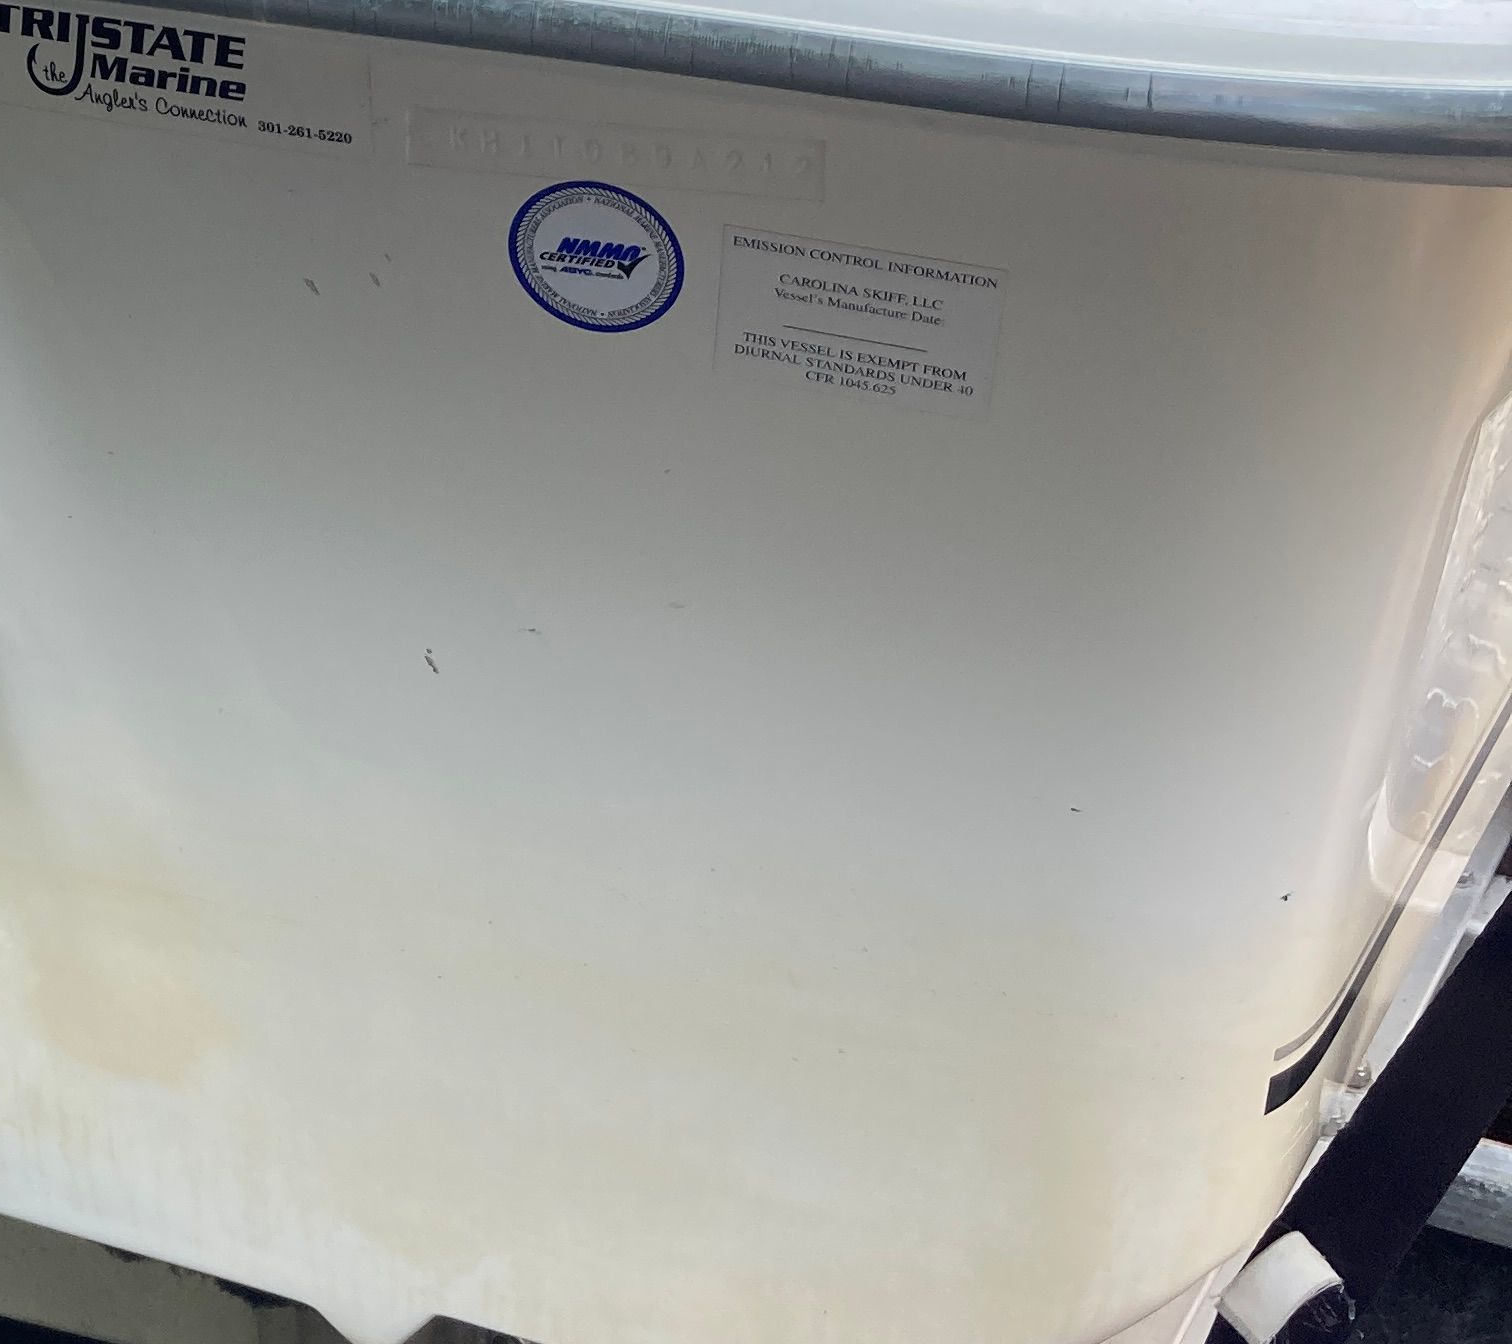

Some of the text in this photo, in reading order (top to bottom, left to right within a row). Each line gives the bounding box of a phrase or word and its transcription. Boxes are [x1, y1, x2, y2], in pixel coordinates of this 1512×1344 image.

[43, 52, 247, 102] the Marine
[74, 83, 248, 128] Angler's Connection
[257, 120, 353, 145] 301-261-5220
[539, 251, 616, 269] CERTIFIED
[732, 235, 999, 289] EMISSION CONTROL INFORMATION
[774, 287, 824, 306] Vessel's
[827, 296, 908, 320] Manufacture
[778, 273, 859, 297] CAROLINA
[912, 295, 945, 311] LLC
[734, 343, 975, 397] DIURNAL STANDARDS UNDER 40
[743, 331, 968, 382] THIS VESSEL IS EXEMPT FROM
[804, 370, 897, 396] CFR 1045.625
